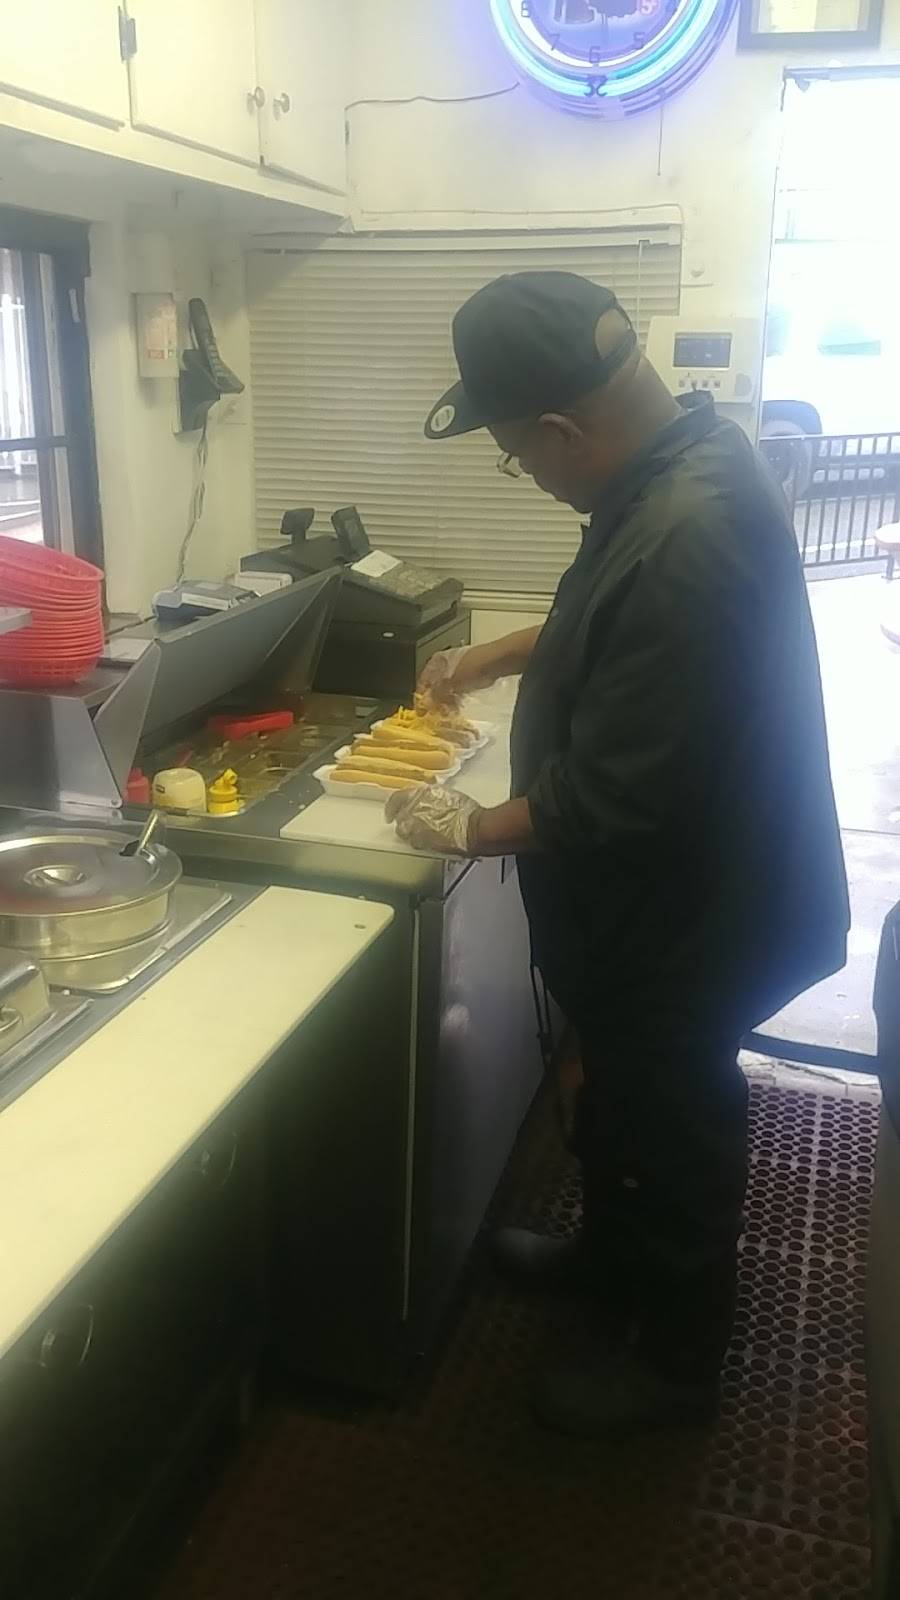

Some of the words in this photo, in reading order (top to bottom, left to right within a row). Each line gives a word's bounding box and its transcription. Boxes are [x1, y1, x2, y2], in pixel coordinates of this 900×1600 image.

[549, 33, 560, 51] 7
[633, 31, 645, 50] 5
[589, 45, 600, 64] 6
